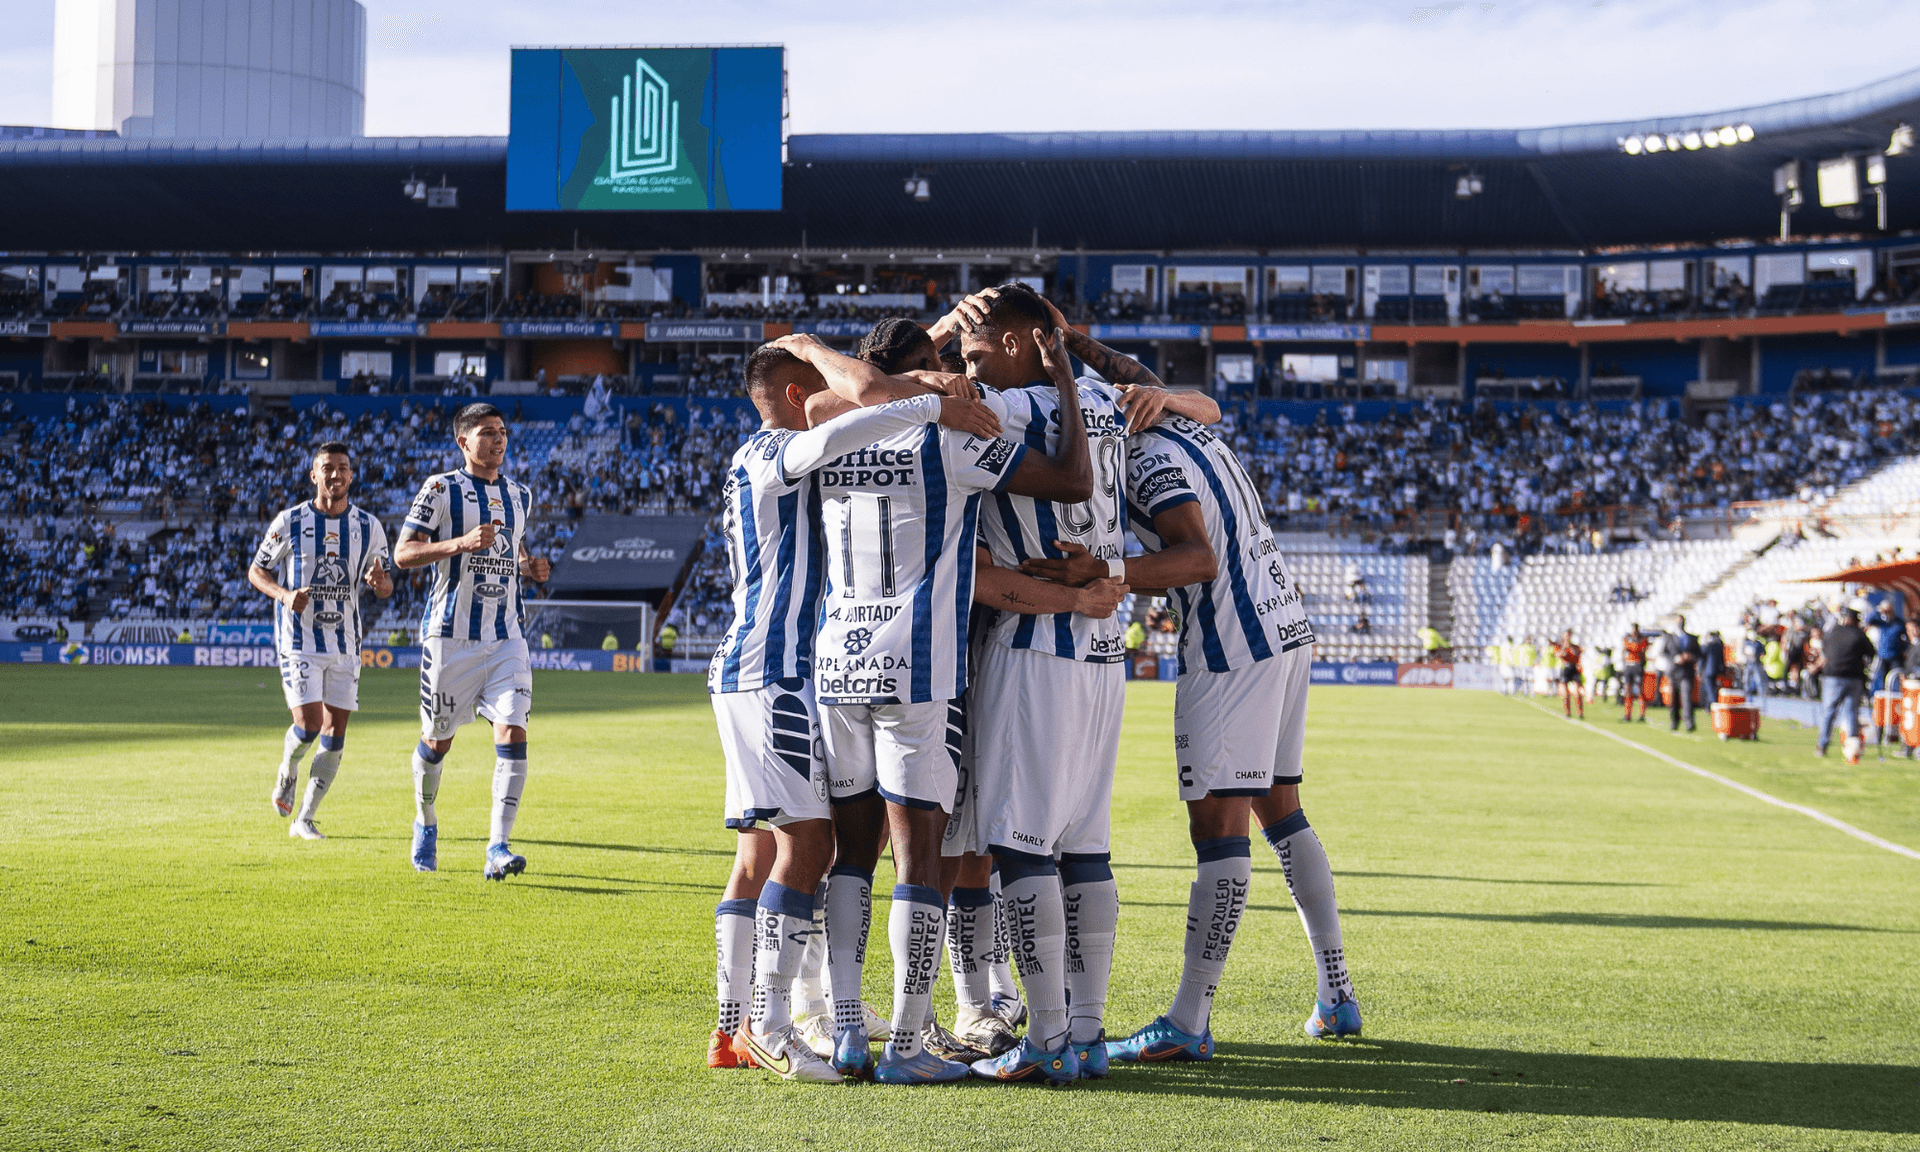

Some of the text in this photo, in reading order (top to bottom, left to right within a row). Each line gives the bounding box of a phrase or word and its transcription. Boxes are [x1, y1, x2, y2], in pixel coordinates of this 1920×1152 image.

[0, 321, 28, 334] UDN
[521, 322, 595, 334] Enrique Borja
[822, 468, 915, 487] DEPOT
[469, 556, 515, 568] CEMENTOS
[571, 546, 676, 563] Corona
[467, 565, 515, 577] FORTALEZA
[210, 626, 276, 645] betc
[1276, 617, 1310, 642] betcr
[93, 645, 170, 665] BIOMSK
[194, 647, 279, 666] RESPIR
[815, 655, 909, 672] XPLANADA
[820, 672, 898, 694] betcris
[1341, 665, 1393, 682] Corona
[1235, 770, 1267, 780] CHARLY
[1012, 830, 1045, 847] CHARLY
[1202, 878, 1230, 961] PEGAZULEJO
[1220, 877, 1248, 946] FORTEC
[1016, 893, 1037, 962] FORTEC
[1065, 892, 1082, 960] FORTEC
[903, 910, 925, 995] PEGAZULEJO
[919, 912, 941, 982] FORTEC
